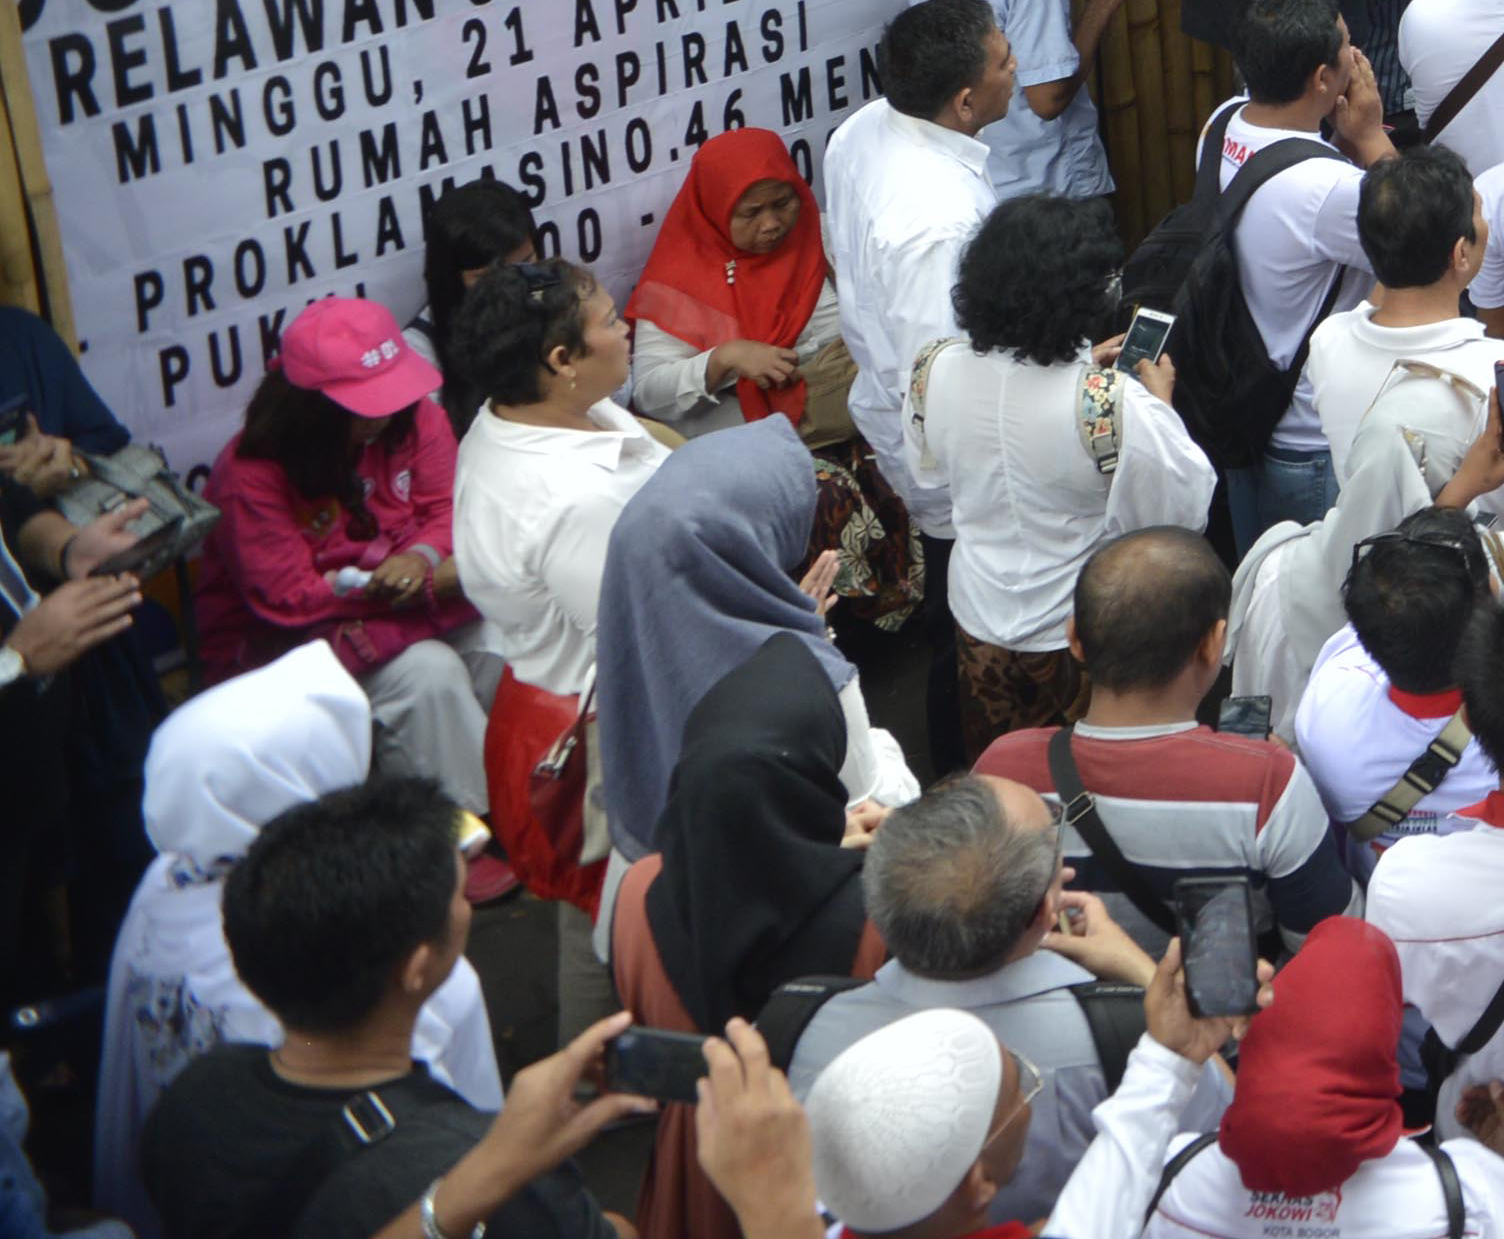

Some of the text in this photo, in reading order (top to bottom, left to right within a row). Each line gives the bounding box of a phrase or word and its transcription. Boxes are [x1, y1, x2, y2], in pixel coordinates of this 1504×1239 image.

[461, 7, 534, 79] 21
[263, 0, 808, 218] RUMAH ASPIRASI
[780, 44, 885, 126] MEN
[1245, 1204, 1314, 1223] JOKOWI
